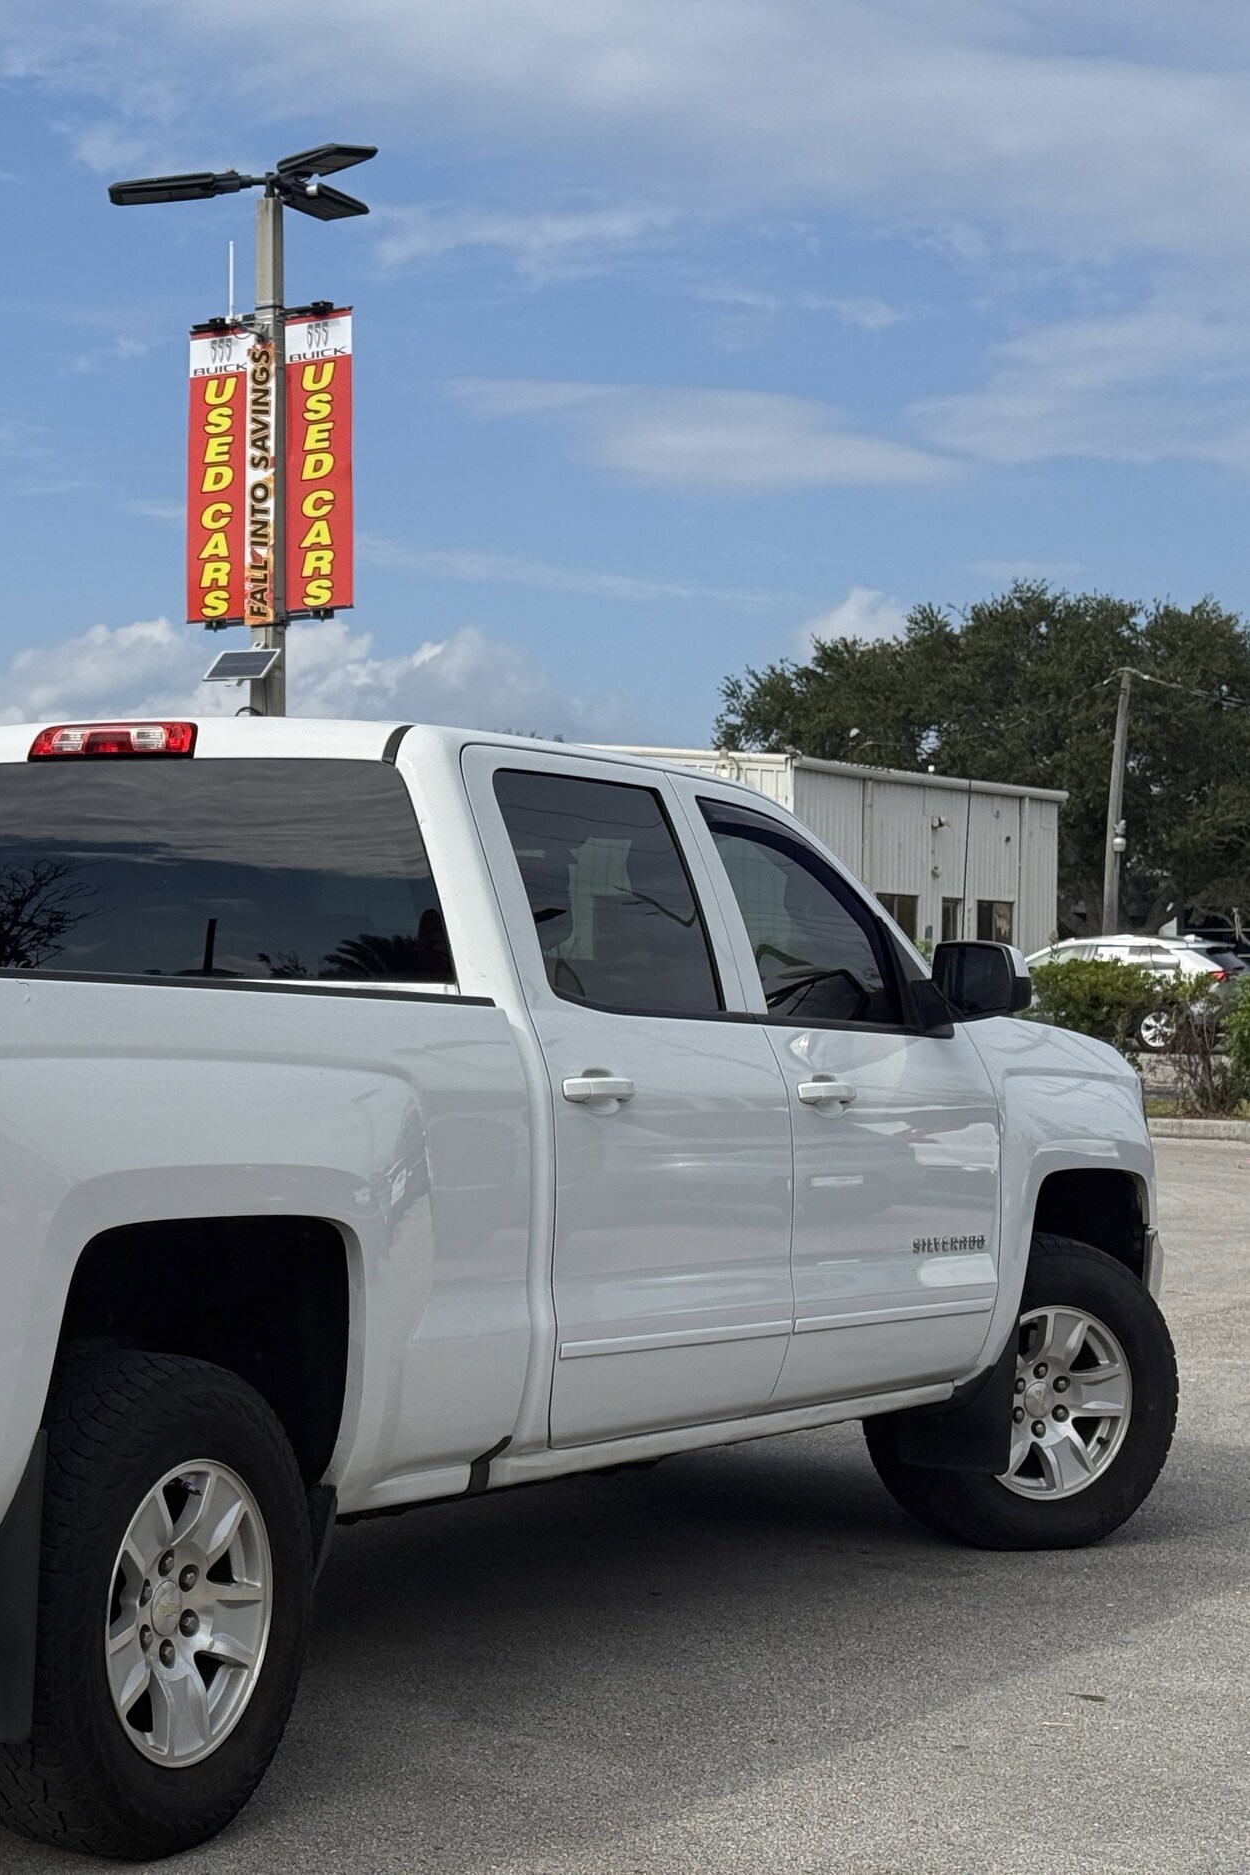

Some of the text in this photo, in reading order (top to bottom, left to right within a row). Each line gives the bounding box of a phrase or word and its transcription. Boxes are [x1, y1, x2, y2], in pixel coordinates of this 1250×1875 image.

[193, 362, 248, 376] BUICK
[289, 345, 347, 362] BUICK
[198, 377, 237, 618] USED CARS
[249, 349, 271, 618] FALL INTO SAVINGS
[300, 361, 335, 608] USED CARS
[912, 1234, 986, 1254] SILVERADO
